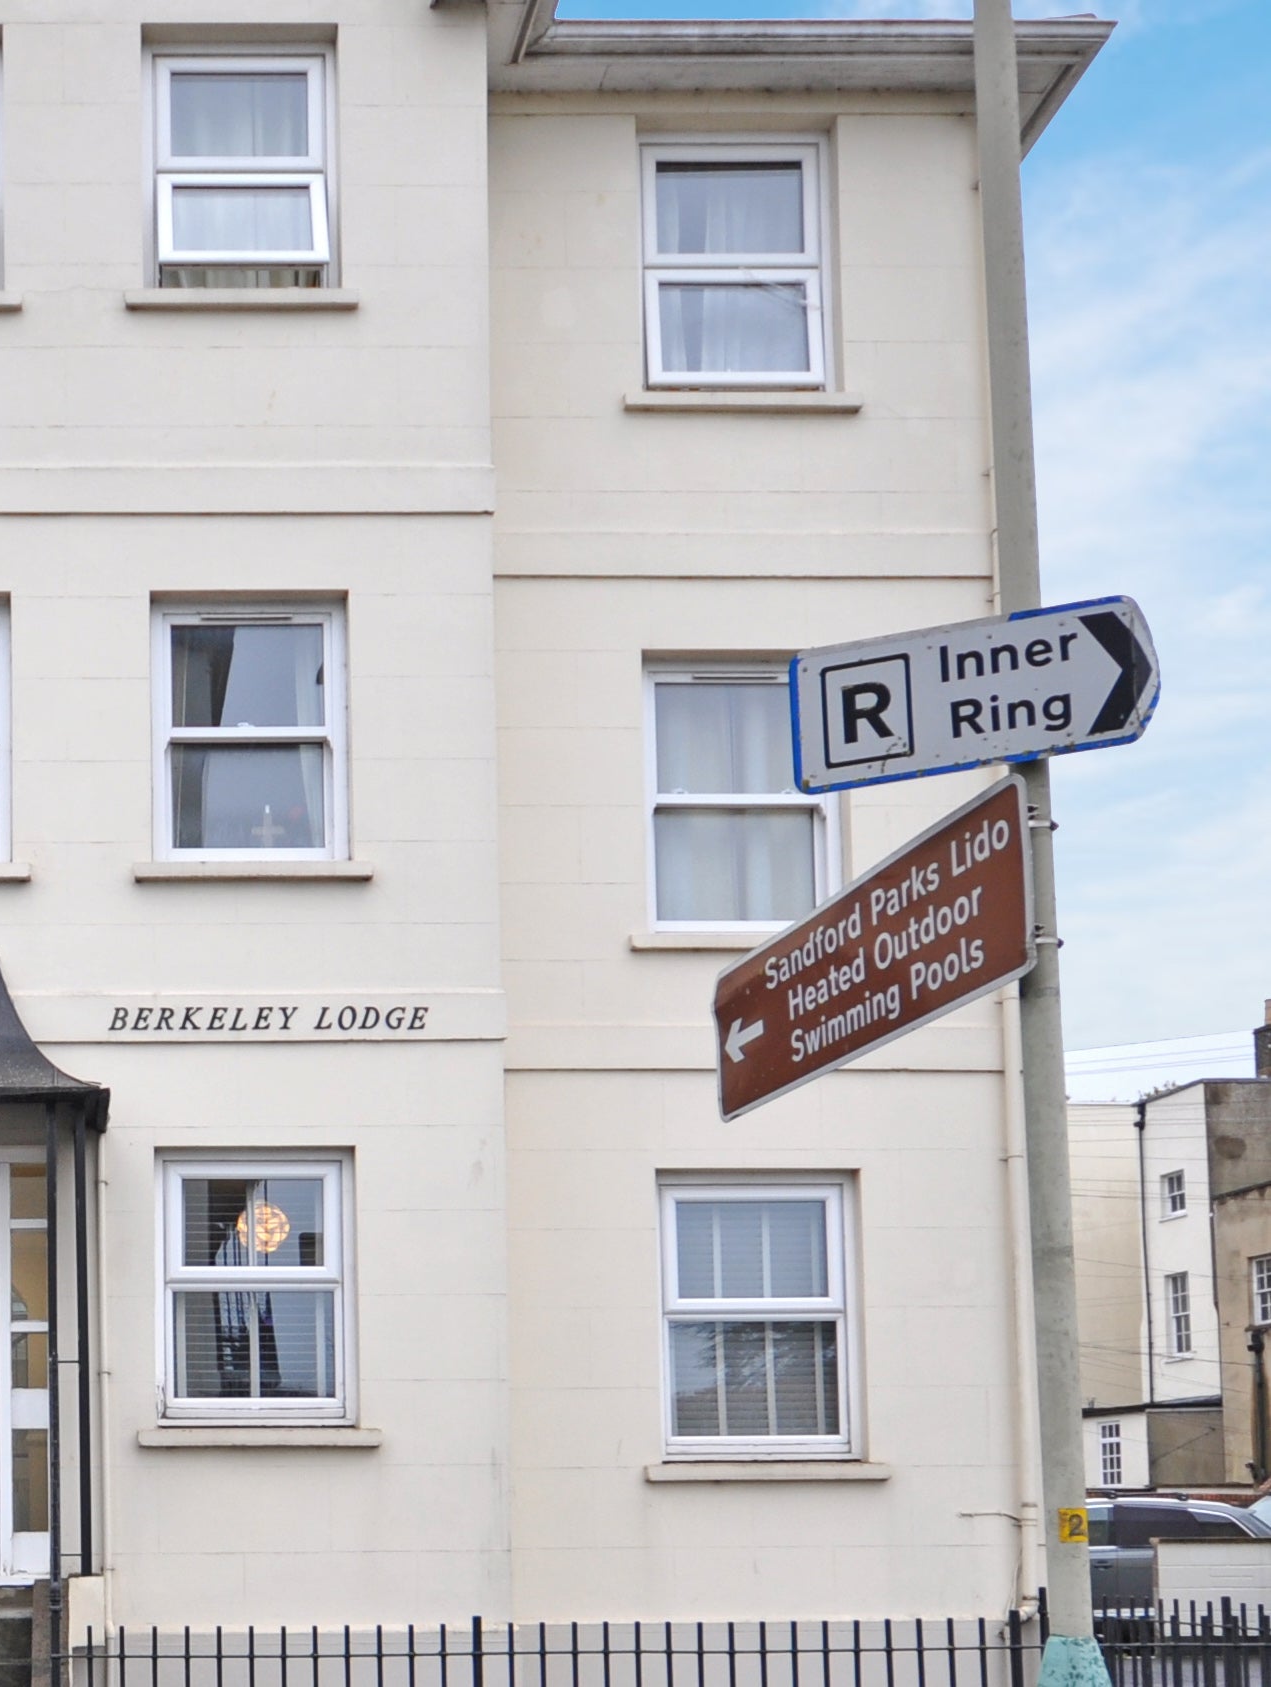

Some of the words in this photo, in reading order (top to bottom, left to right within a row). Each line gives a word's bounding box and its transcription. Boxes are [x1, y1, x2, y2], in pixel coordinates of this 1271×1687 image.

[939, 632, 1078, 683] Inner
[841, 681, 895, 745] R
[950, 693, 1073, 739] Ring
[764, 902, 862, 990] Sandford
[870, 861, 940, 926] Parks
[950, 818, 1010, 877] Lido
[788, 947, 866, 1021] Heated
[873, 886, 983, 971] Outdoor
[108, 1006, 299, 1031] BERKELEY
[313, 1005, 429, 1031] LODGE
[790, 984, 901, 1063] Swimming
[909, 938, 985, 1001] Pools
[1069, 1513, 1084, 1537] 2
